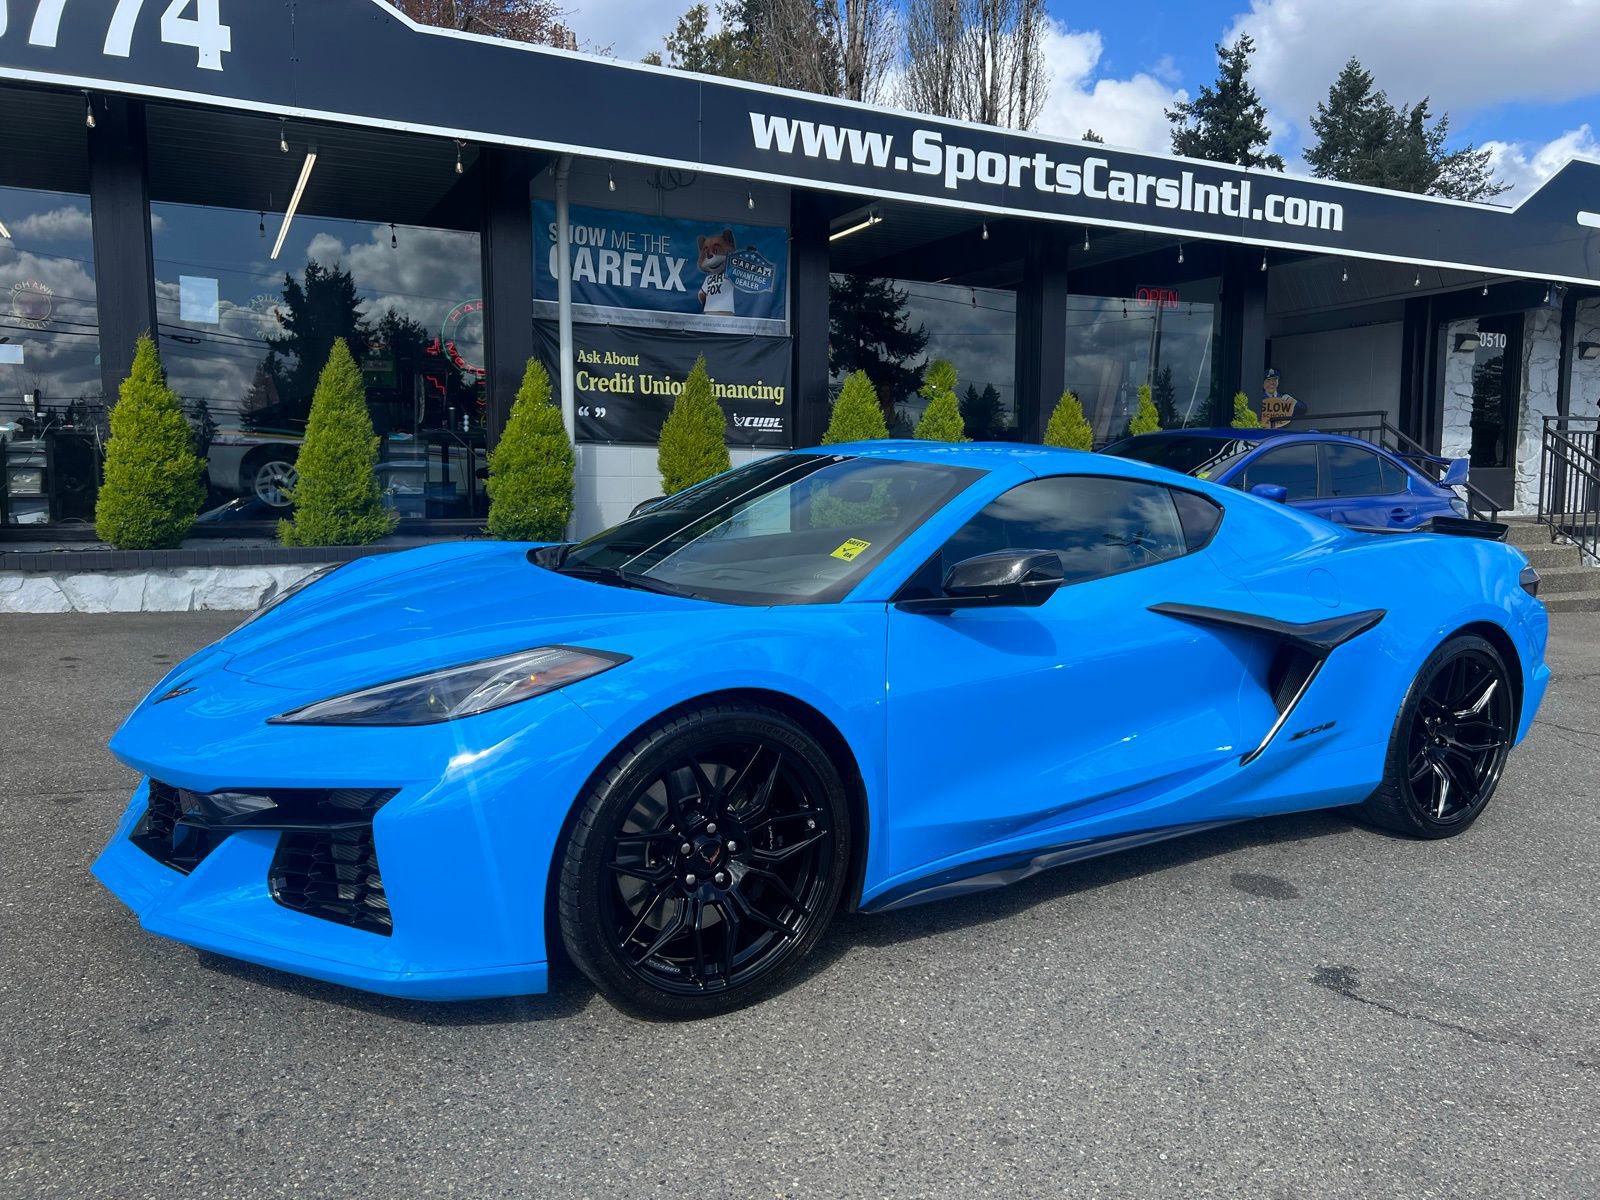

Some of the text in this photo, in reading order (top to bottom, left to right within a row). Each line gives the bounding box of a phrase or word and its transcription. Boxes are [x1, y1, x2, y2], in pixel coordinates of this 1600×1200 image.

[0, 0, 231, 71] 774
[749, 111, 1344, 232] www.SportsCarsIntl.com
[549, 222, 671, 255] SOW ME THE
[732, 258, 772, 277] CARFAX
[732, 268, 767, 285] ADVANTAGE
[735, 278, 759, 291] DEALER
[1137, 287, 1178, 308] OPEN
[1478, 332, 1507, 348] 0510
[577, 350, 639, 366] Ask About
[576, 371, 634, 394] Credit
[711, 378, 784, 405] inancing
[1262, 402, 1292, 413] SLOW
